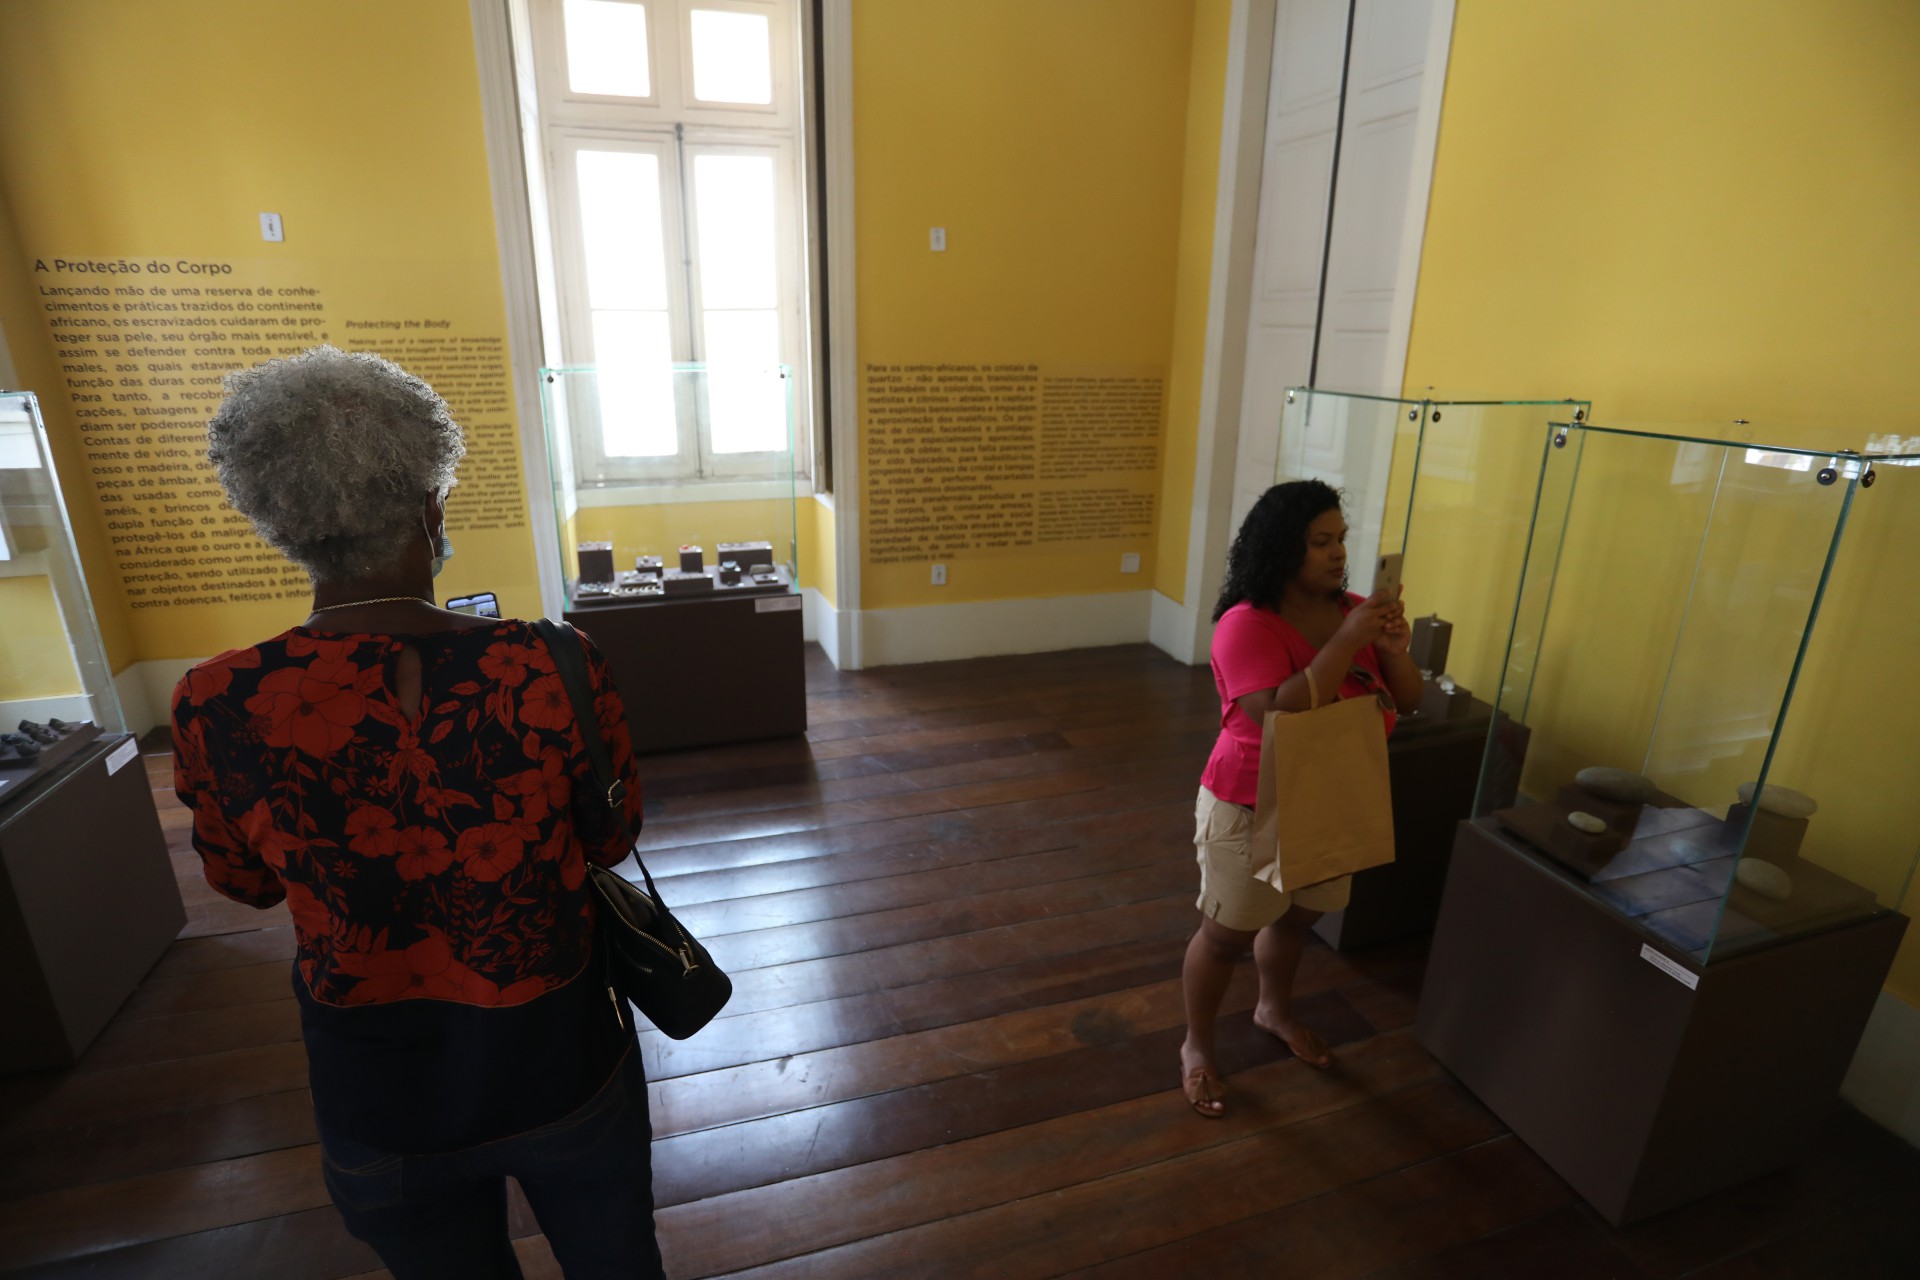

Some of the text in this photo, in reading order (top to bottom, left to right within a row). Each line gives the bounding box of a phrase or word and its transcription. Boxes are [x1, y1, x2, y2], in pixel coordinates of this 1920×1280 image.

[34, 259, 232, 277] A Proteção do Corpo
[40, 285, 320, 299] Lançando mão de uma reserva de conhe-
[44, 300, 323, 314] cimentos e práticas trazidos do continente
[49, 315, 326, 329] africano, os escravizados cuidaram de pro-
[346, 321, 401, 329] Protecting
[424, 320, 451, 329] Body
[54, 333, 91, 345] teger
[96, 334, 120, 342] sua
[124, 331, 157, 344] pele,
[161, 333, 184, 342] seu
[188, 330, 227, 344] órgão
[231, 330, 260, 341] mais
[265, 330, 318, 343] sensível,
[57, 346, 97, 358] assim
[105, 349, 120, 357] se
[126, 346, 186, 357] defender
[194, 346, 235, 356] contra
[242, 345, 271, 356] toda
[62, 360, 244, 375] males, aos quais estavam
[67, 376, 114, 391] função
[119, 376, 142, 387] das
[148, 375, 184, 386] duras
[71, 392, 102, 403] Para
[113, 392, 151, 404] tanto,
[75, 406, 126, 420] cações,
[133, 405, 198, 418] tatuagens
[79, 420, 113, 432] diam
[117, 422, 136, 431] ser
[83, 432, 208, 446] Contas de diferent
[87, 450, 129, 460] mente
[133, 448, 150, 459] de
[154, 447, 191, 460] vidro,
[92, 466, 123, 475] osso
[137, 461, 192, 474] madeira,
[96, 480, 135, 491] peças
[138, 476, 154, 487] de
[158, 475, 201, 488] âmbar,
[100, 490, 221, 502] das usadas como
[104, 505, 141, 518] anéis,
[164, 501, 210, 513] brincos
[108, 519, 144, 532] dupla
[151, 516, 194, 530] função
[200, 515, 216, 525] de
[112, 530, 185, 545] protegê-los
[190, 529, 205, 539] da
[116, 549, 131, 557] na
[134, 543, 172, 556] África
[175, 545, 199, 555] que
[213, 542, 241, 551] ouro
[119, 556, 195, 570] considerado
[198, 556, 232, 565] como
[234, 555, 253, 563] um
[123, 570, 182, 585] proteção,
[186, 568, 223, 579] sendo
[226, 564, 278, 576] utilizado
[127, 588, 147, 596] nar
[151, 582, 197, 596] objetos
[200, 578, 265, 591] destinados
[269, 577, 276, 587] à
[131, 598, 170, 609] contra
[173, 594, 227, 608] doenças,
[229, 590, 272, 604] feitiços
